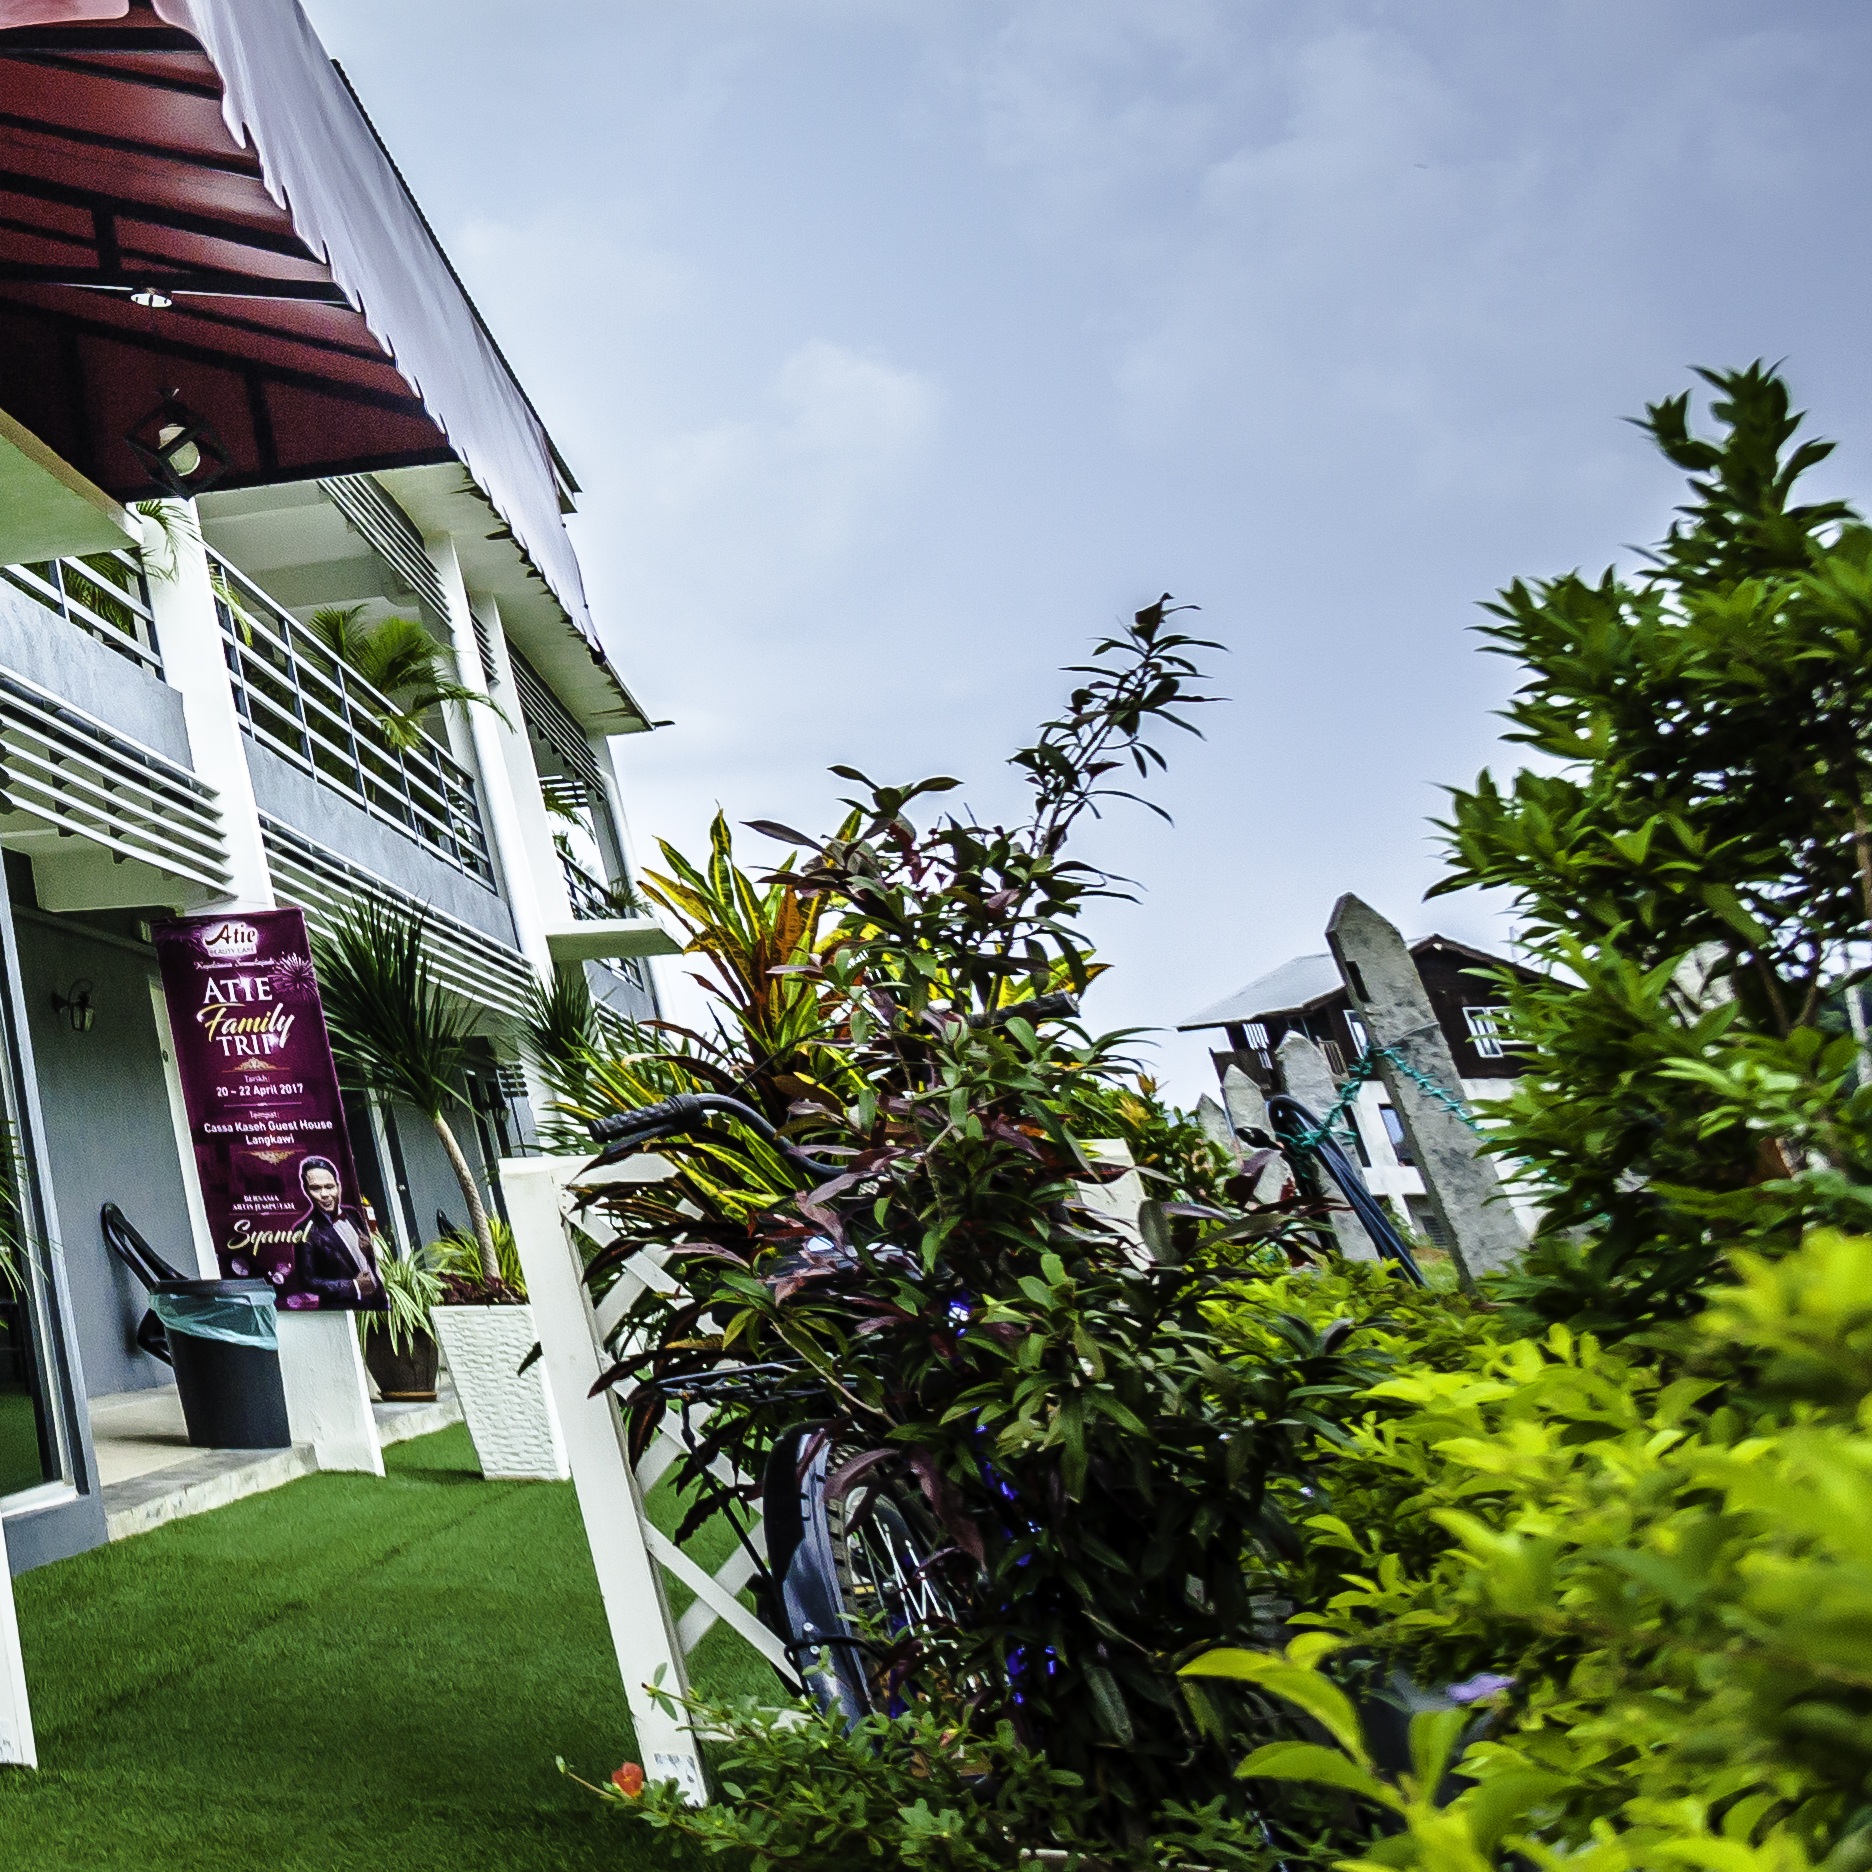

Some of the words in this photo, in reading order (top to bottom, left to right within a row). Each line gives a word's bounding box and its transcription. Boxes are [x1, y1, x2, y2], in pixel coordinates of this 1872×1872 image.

[204, 923, 256, 946] Atie
[203, 976, 273, 1004] ATIE
[196, 1002, 295, 1049] Family
[216, 1033, 279, 1056] TRIP
[216, 1086, 229, 1097] 20
[238, 1085, 251, 1096] 22
[253, 1084, 279, 1097] April
[279, 1083, 304, 1094] 2017
[204, 1122, 234, 1133] Cassa
[299, 1119, 333, 1130] House
[245, 1133, 295, 1147] Langkawi
[227, 1219, 314, 1257] Syamel
